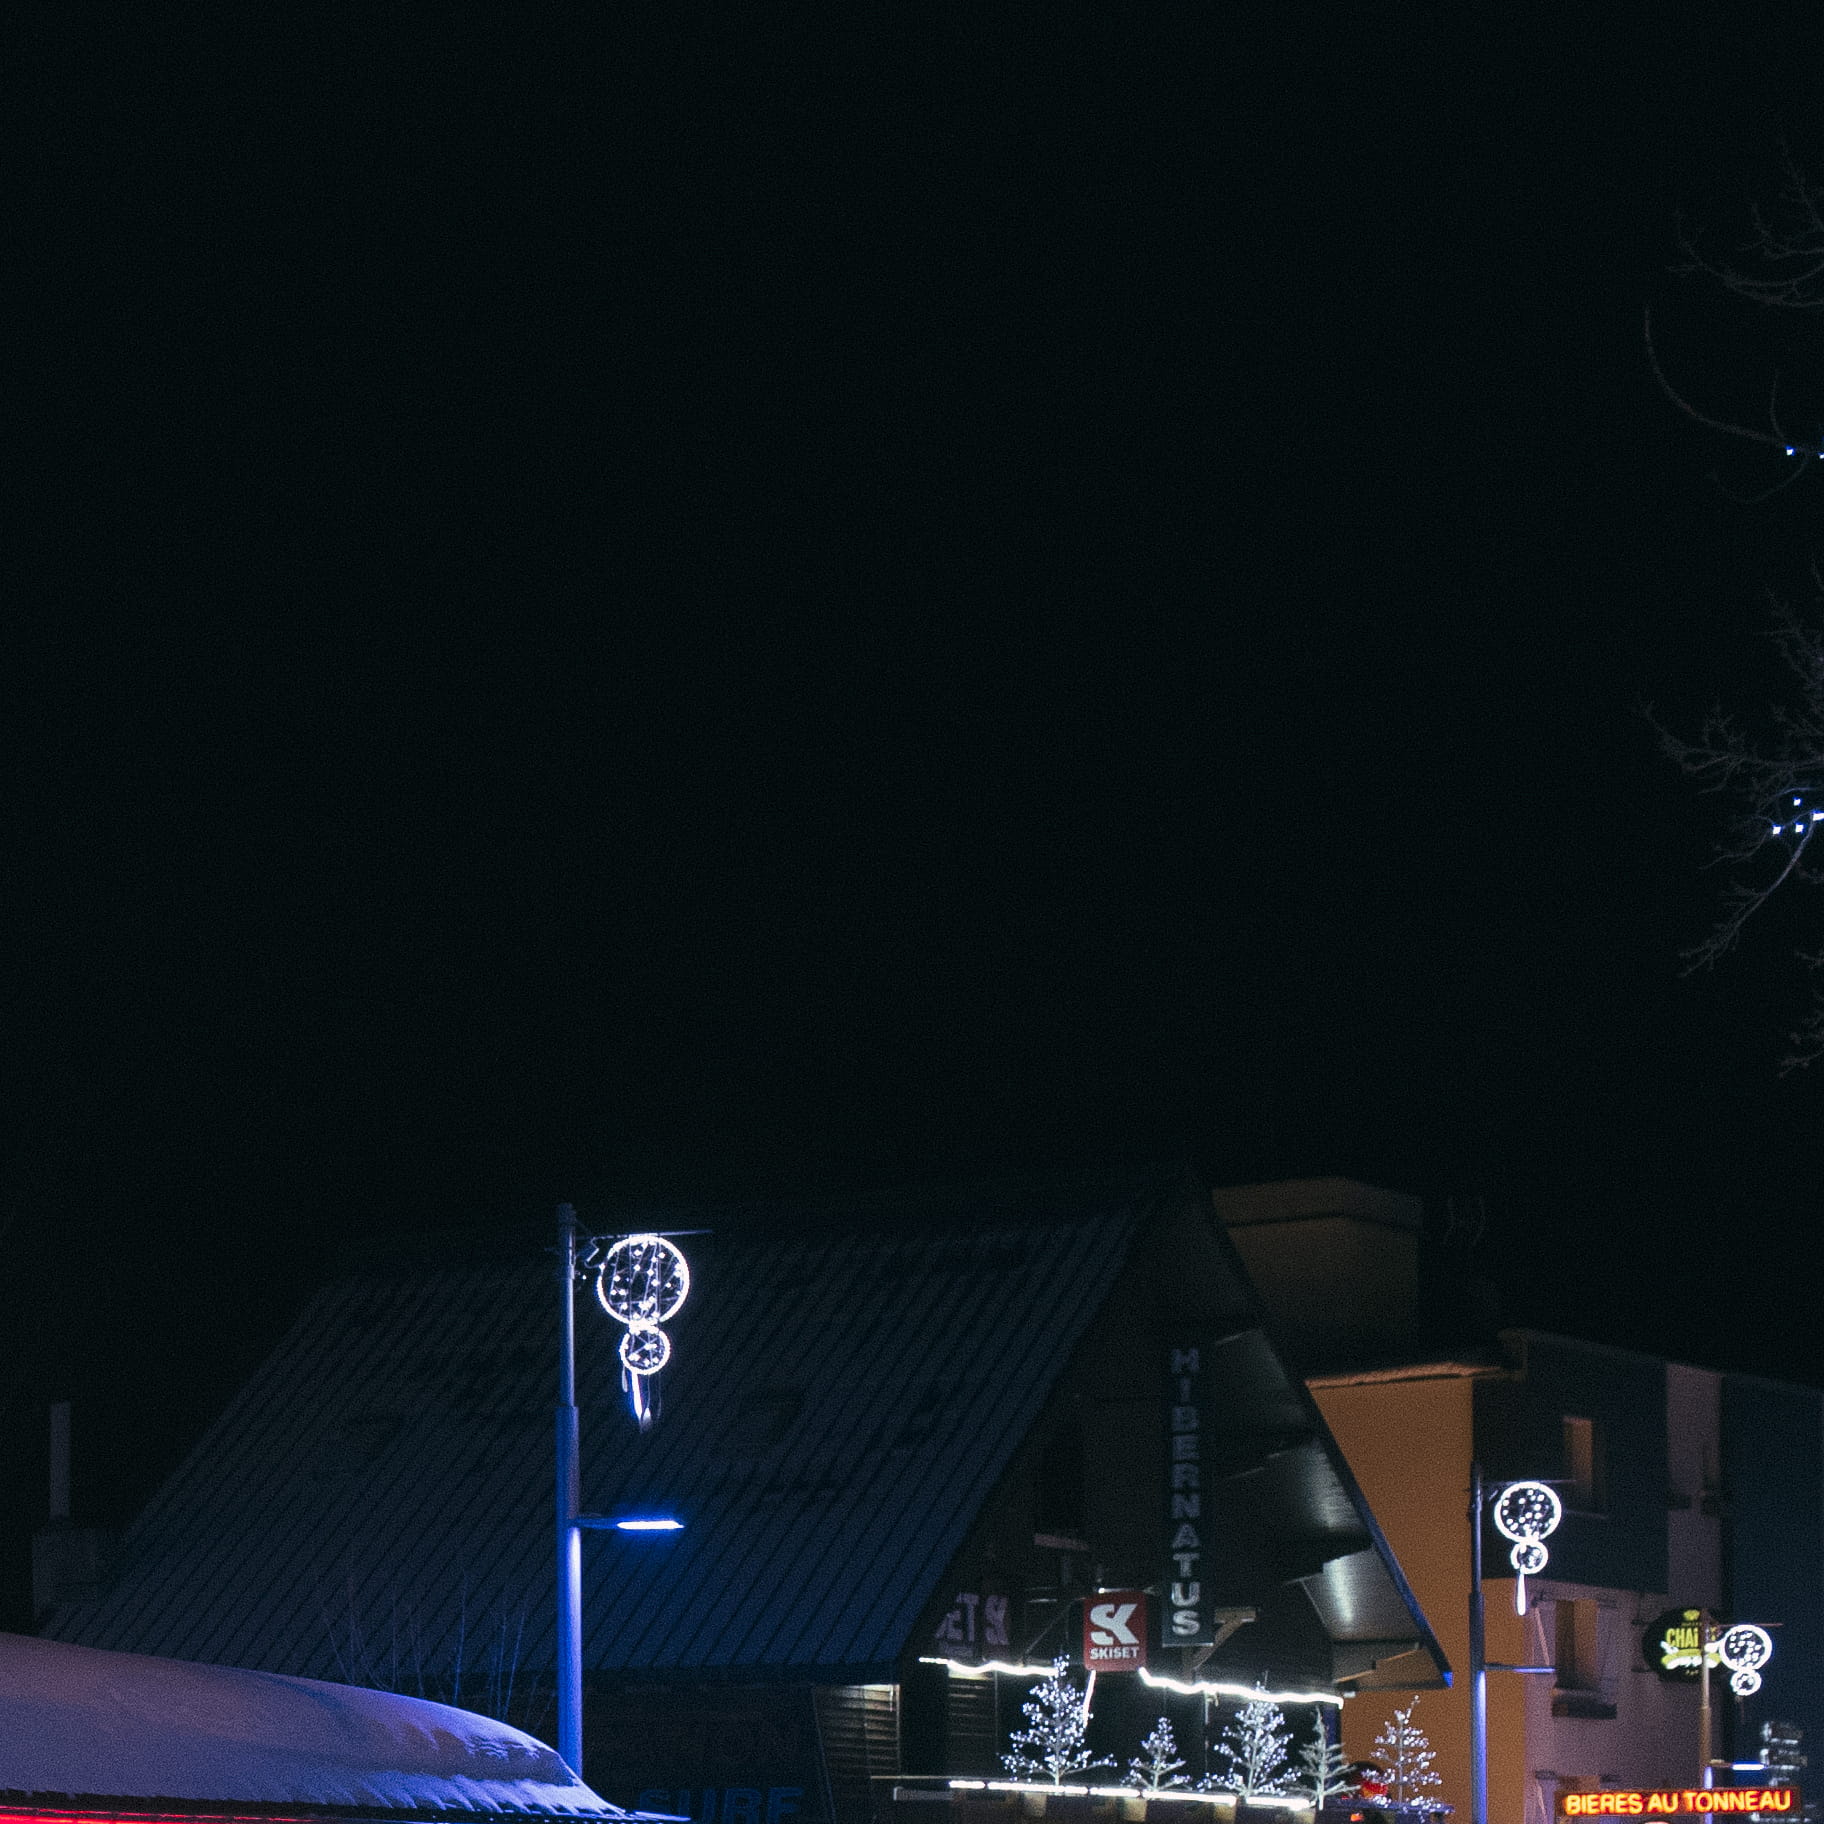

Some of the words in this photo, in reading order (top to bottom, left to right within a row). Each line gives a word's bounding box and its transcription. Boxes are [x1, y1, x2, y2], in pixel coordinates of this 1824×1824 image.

[1170, 1346, 1200, 1635] HIBERNATUS
[1089, 1646, 1139, 1661] SKISET
[1564, 1792, 1643, 1815] BIERES
[1646, 1791, 1679, 1813] AU
[1683, 1789, 1791, 1813] TONNEAU
